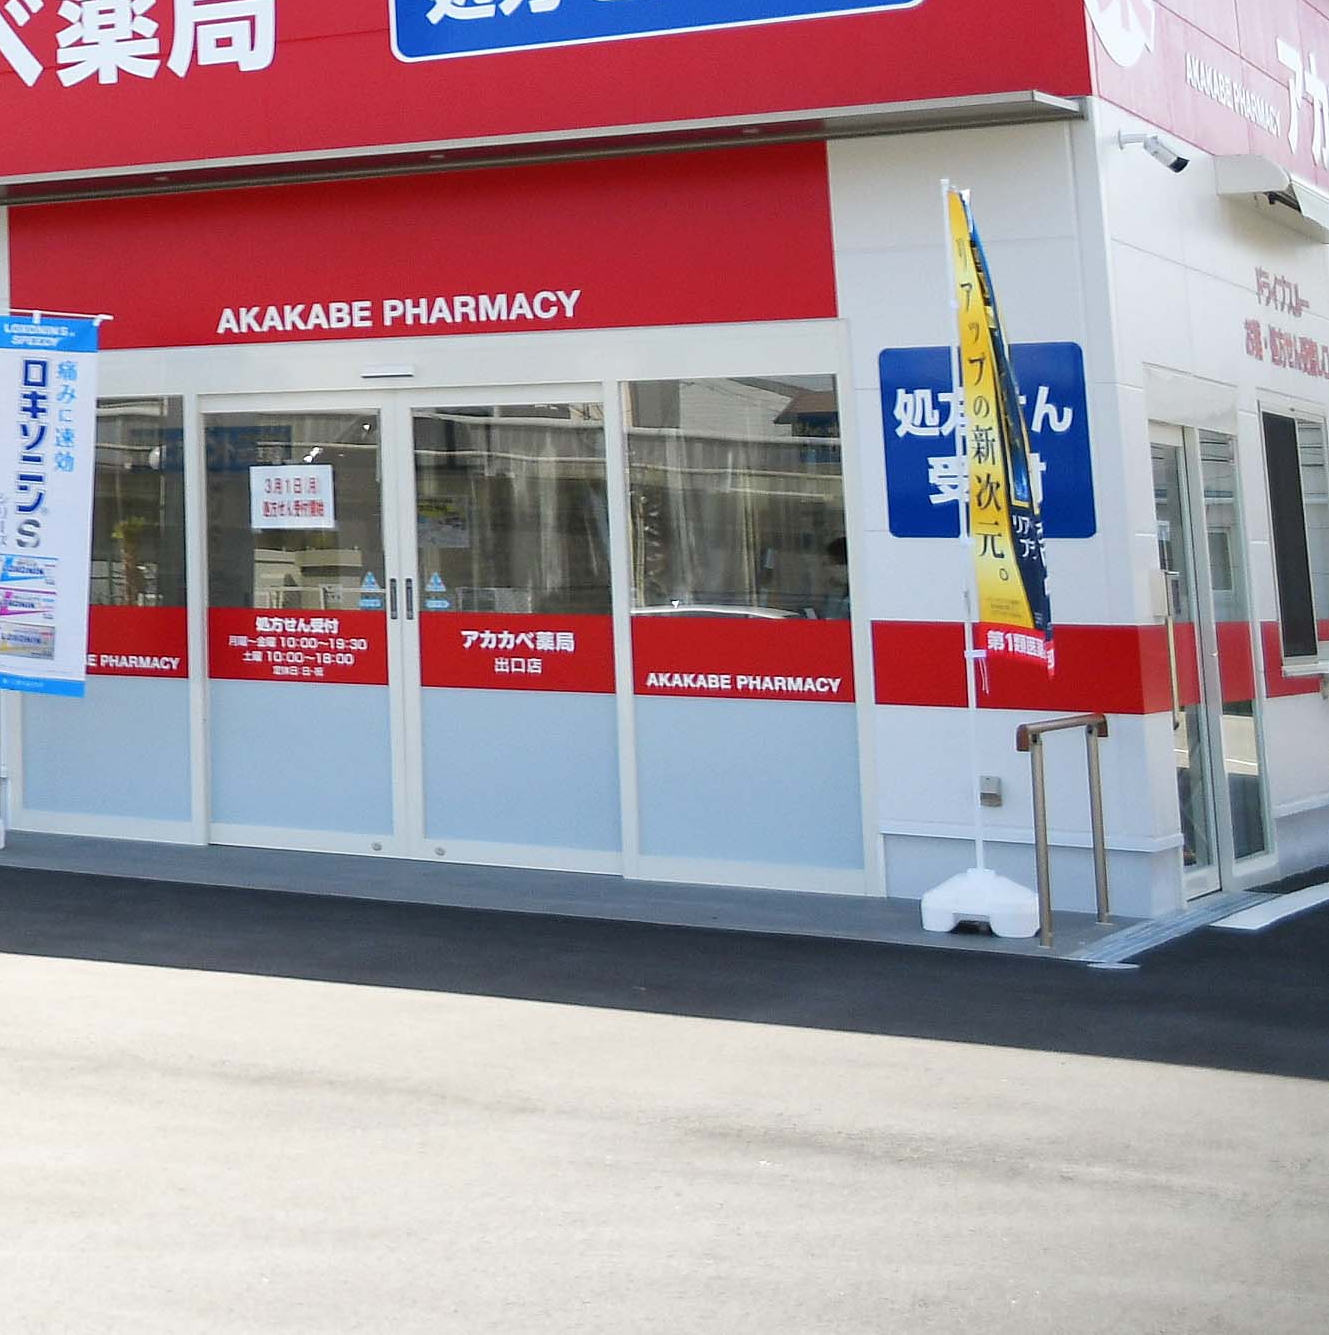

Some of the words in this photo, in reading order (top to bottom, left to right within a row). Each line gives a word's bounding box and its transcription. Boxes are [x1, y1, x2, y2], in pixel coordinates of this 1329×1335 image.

[216, 301, 373, 334] AKAKABE
[382, 289, 582, 327] PHARMACY
[54, 360, 79, 472] 痛みに速効
[893, 386, 1074, 439] 処ん
[16, 359, 49, 548] ロキソニンS
[255, 616, 339, 634] 処方せん受付
[460, 629, 575, 653] アカカベ薬局
[100, 654, 181, 670] PHARMACY
[494, 657, 543, 674] 出口店
[646, 672, 732, 690] AKAKABE
[736, 674, 842, 694] PHARMACY
